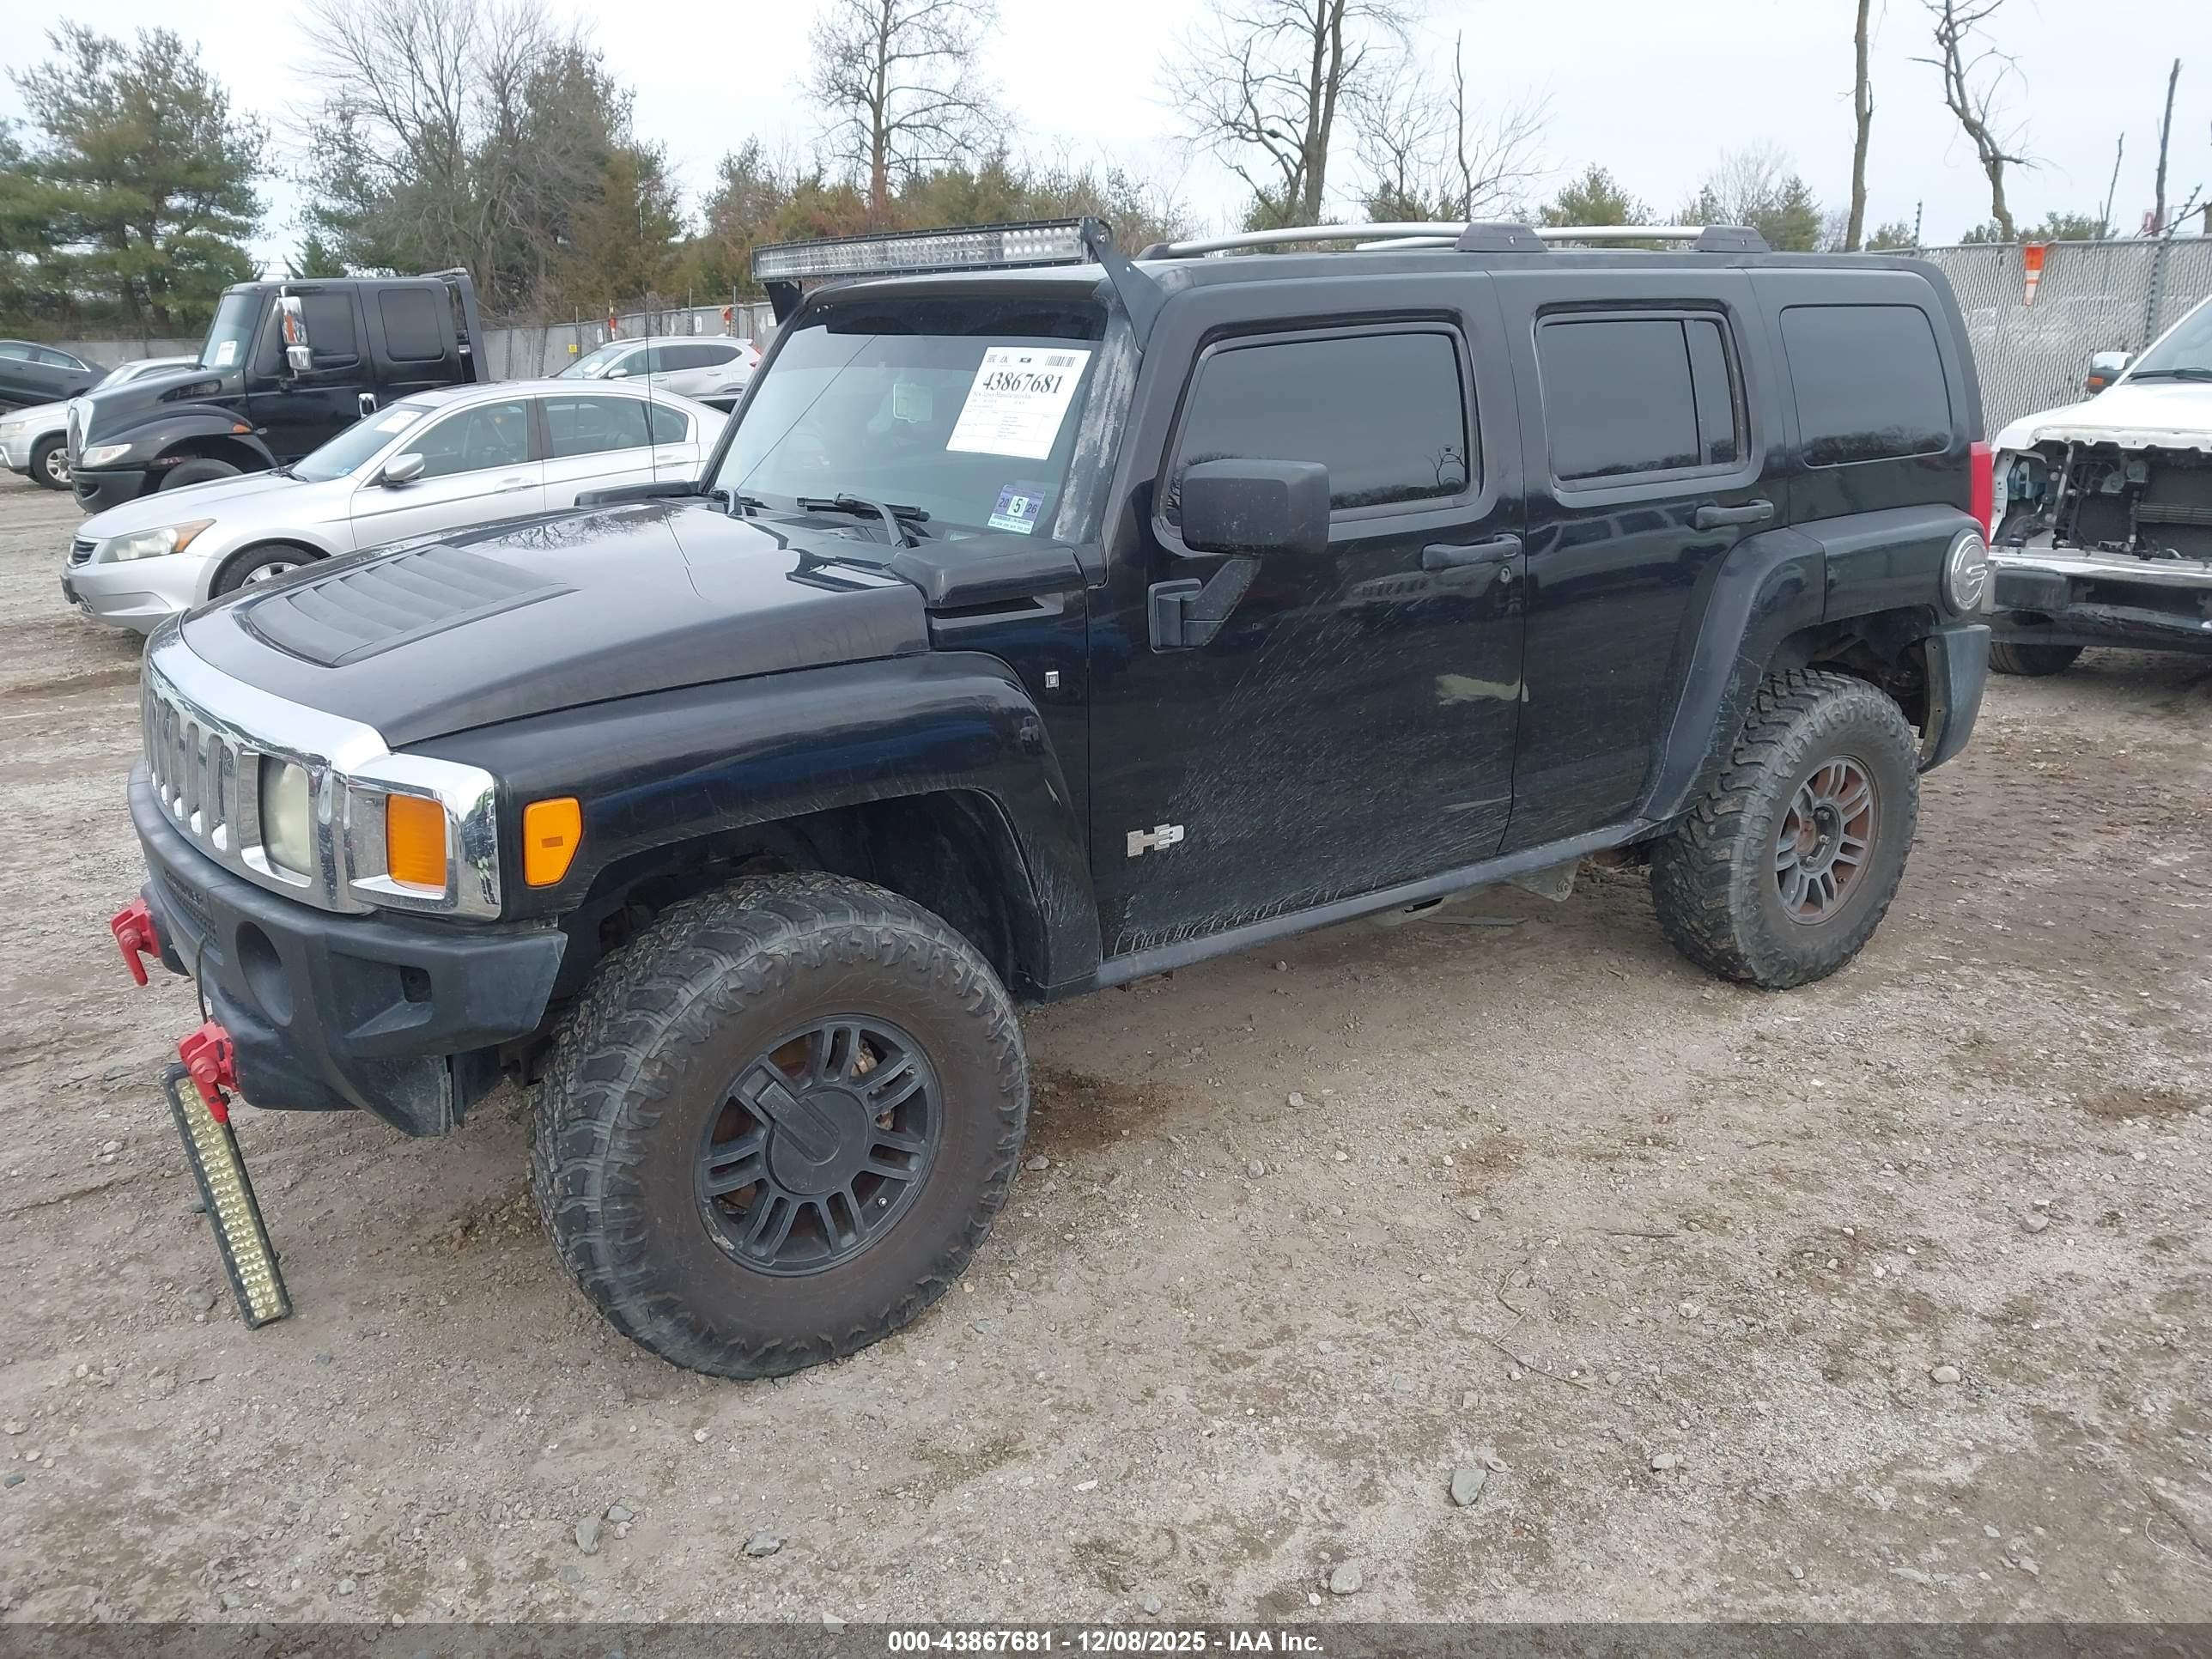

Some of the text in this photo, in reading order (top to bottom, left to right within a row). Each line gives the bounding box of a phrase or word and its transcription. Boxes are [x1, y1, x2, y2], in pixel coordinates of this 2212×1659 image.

[983, 372, 1064, 394] 43867681
[999, 497, 1038, 514] 20 5 26
[1127, 823, 1184, 858] H3
